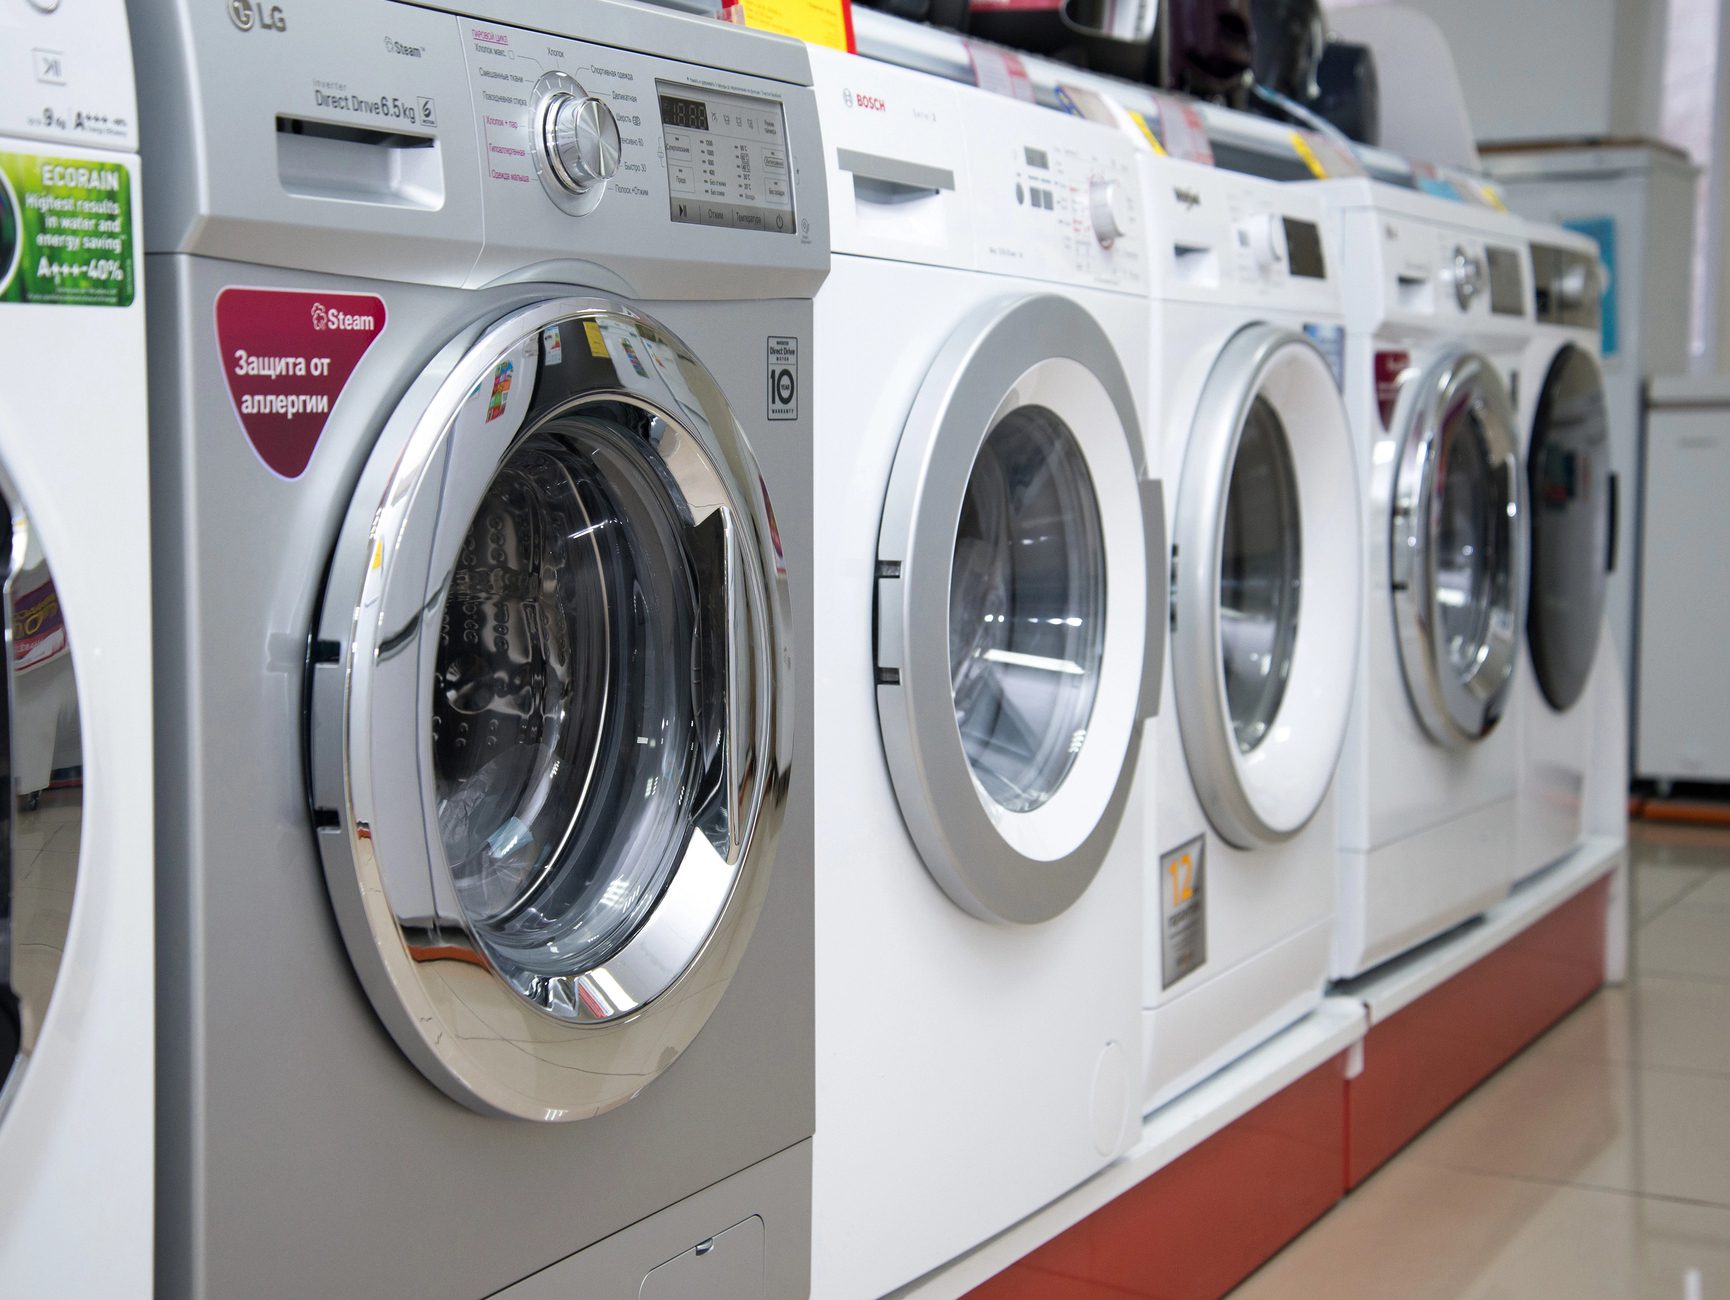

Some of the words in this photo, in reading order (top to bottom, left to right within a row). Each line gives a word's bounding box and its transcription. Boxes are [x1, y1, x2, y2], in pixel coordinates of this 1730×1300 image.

[257, 2, 287, 33] LG
[547, 47, 565, 58] Хлопок
[315, 89, 350, 111] Direct
[351, 94, 380, 116] Drive
[856, 93, 886, 112] BOSCH
[43, 107, 54, 128] 9
[42, 164, 119, 191] ECORAIN
[624, 161, 641, 173] Быстро
[25, 191, 75, 213] Highest
[77, 197, 120, 216] results
[707, 208, 724, 220] Отжим
[45, 213, 59, 229] in
[61, 217, 96, 232] water
[99, 218, 121, 233] and
[36, 233, 81, 251] energy
[327, 308, 374, 331] Steam
[769, 346, 783, 355] Direct
[783, 347, 795, 356] Drive
[234, 349, 306, 380] Защита
[310, 358, 331, 377] от
[770, 368, 795, 405] 10
[241, 394, 329, 420] аллергии
[1168, 853, 1193, 907] 12
